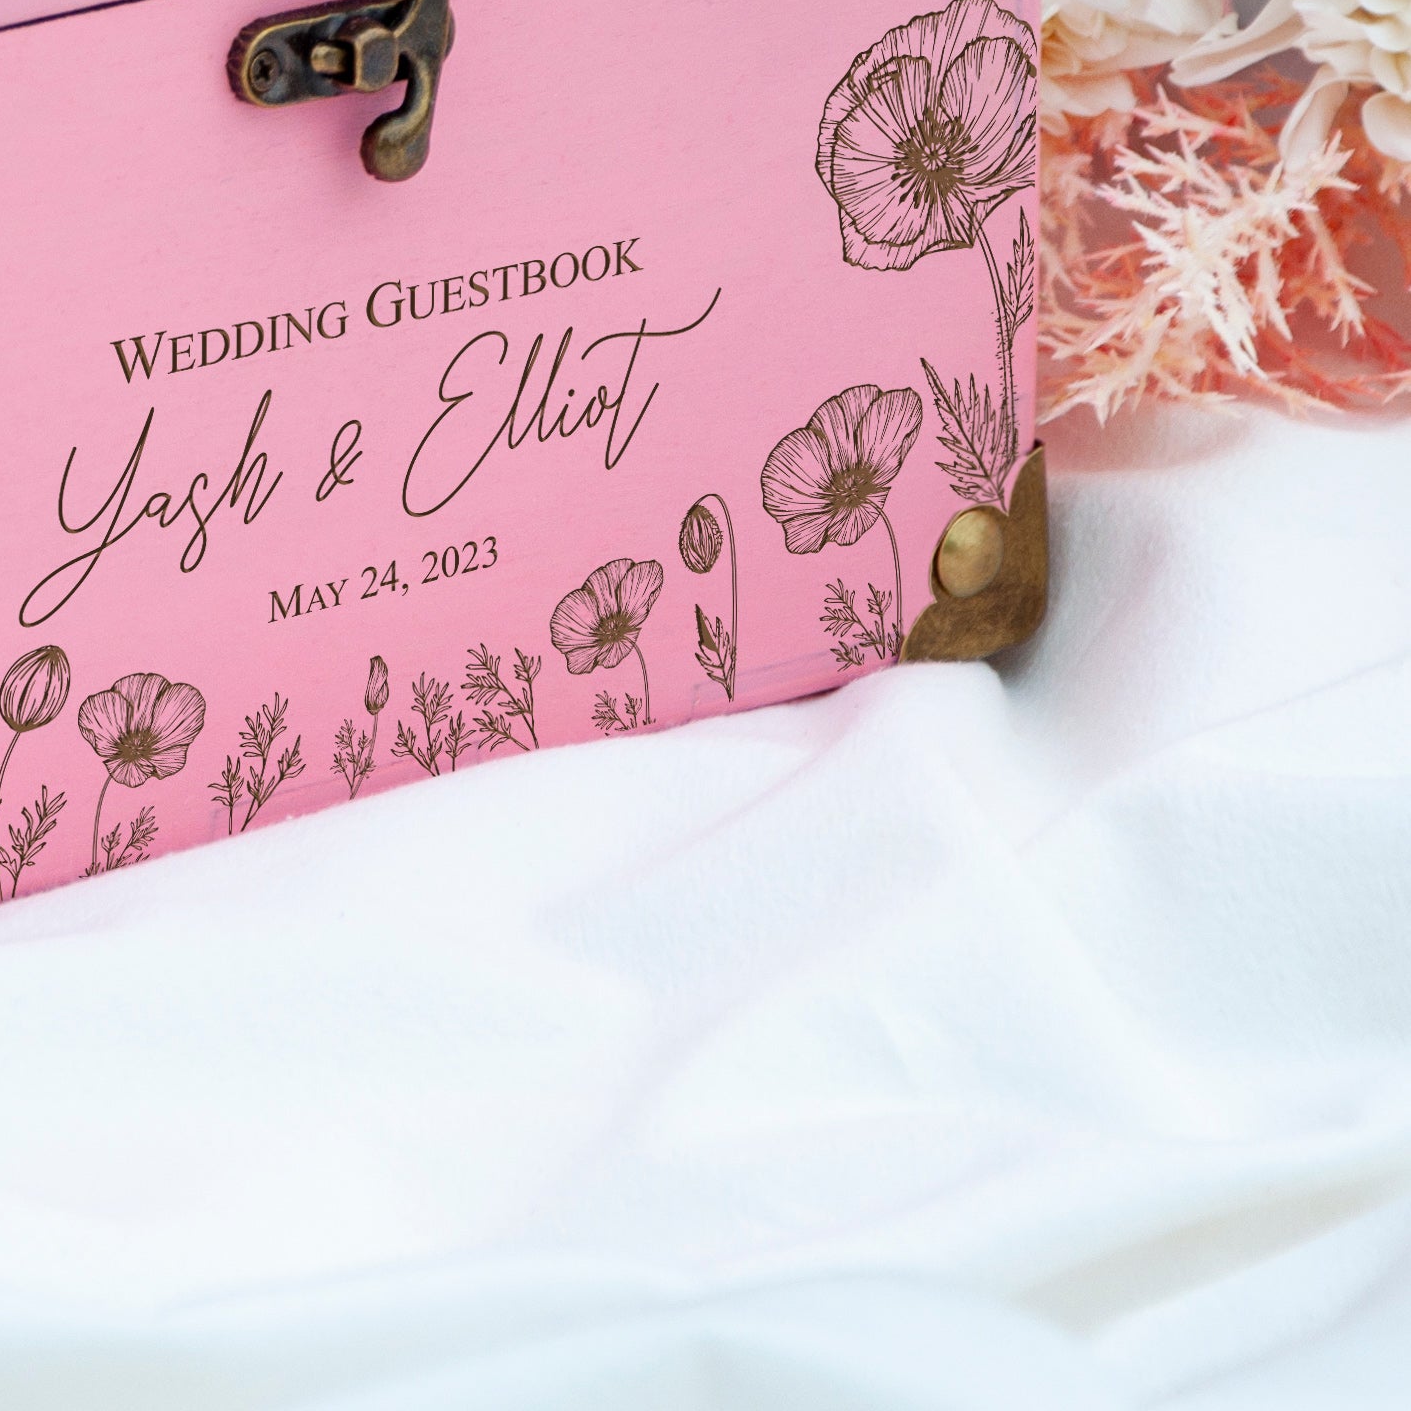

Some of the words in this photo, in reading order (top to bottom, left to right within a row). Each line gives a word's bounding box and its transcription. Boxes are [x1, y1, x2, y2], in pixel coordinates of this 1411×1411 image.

[110, 301, 348, 383] WEDDING
[366, 238, 643, 327] GUESTBOOK
[19, 390, 283, 627] Yash
[316, 420, 362, 501] &
[402, 288, 721, 517] Elliot
[268, 579, 348, 623] MAY
[361, 557, 411, 600] 24,
[422, 537, 498, 585] 2023
